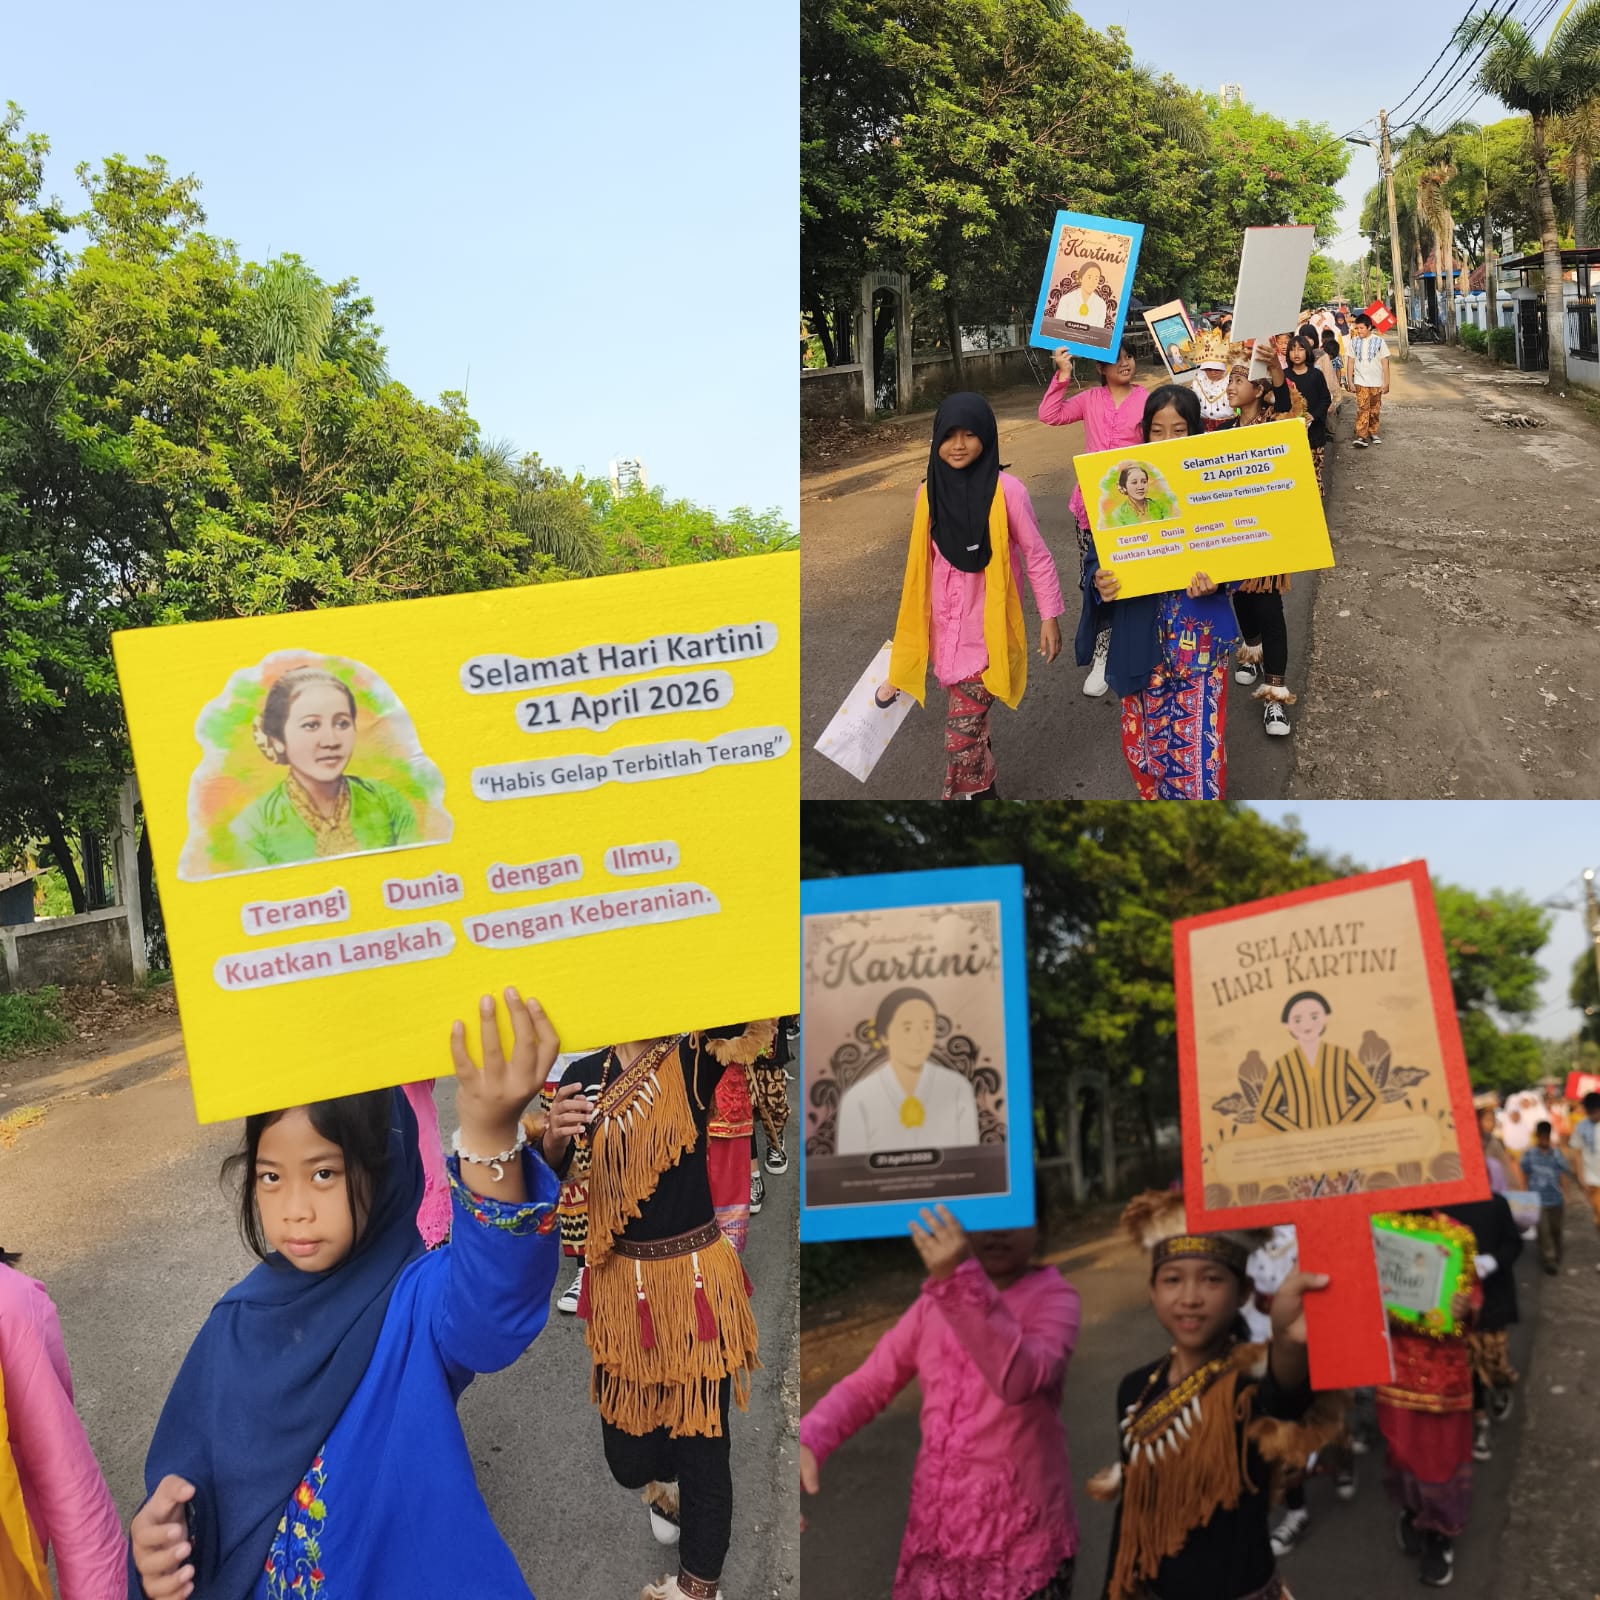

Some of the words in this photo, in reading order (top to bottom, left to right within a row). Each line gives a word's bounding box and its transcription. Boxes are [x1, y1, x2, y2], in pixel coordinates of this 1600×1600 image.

[1064, 238, 1123, 264] Kartini
[1183, 456, 1225, 470] Selamat
[1227, 450, 1248, 462] Hari
[1250, 444, 1285, 459] Kartini
[1203, 471, 1216, 481] 21
[1219, 466, 1243, 480] April
[1245, 462, 1270, 475] 2026
[1112, 551, 1146, 562] Kuatkan
[1147, 544, 1180, 557] Langkah
[1189, 538, 1220, 550] Dengan
[1221, 531, 1270, 544] Keberanian.
[1119, 533, 1149, 545] Terangi
[1161, 527, 1185, 538] Dunia
[1194, 521, 1224, 533] dengan
[468, 652, 590, 689] Selamat
[598, 639, 657, 671] Hari
[667, 624, 763, 662] Kartini
[525, 701, 561, 726] 21
[571, 688, 639, 724] April
[648, 678, 719, 710] 2026
[479, 772, 545, 794] “Habis
[551, 764, 608, 789] Gelap
[613, 749, 702, 775] Terbitlah
[706, 736, 783, 758] Terang”
[249, 889, 346, 927] Terangi
[387, 874, 459, 904] Dunia
[491, 858, 579, 889] dengan
[611, 846, 673, 869] Ilmu,
[225, 950, 332, 984] Kuatkan
[339, 927, 442, 964] Langkah
[472, 913, 563, 943] Dengan
[570, 887, 713, 926] Keberanian.
[1236, 921, 1365, 969] SELAMAT
[823, 940, 987, 990] Kartini
[1211, 966, 1273, 1007] HARI
[1284, 947, 1397, 985] KARTINI
